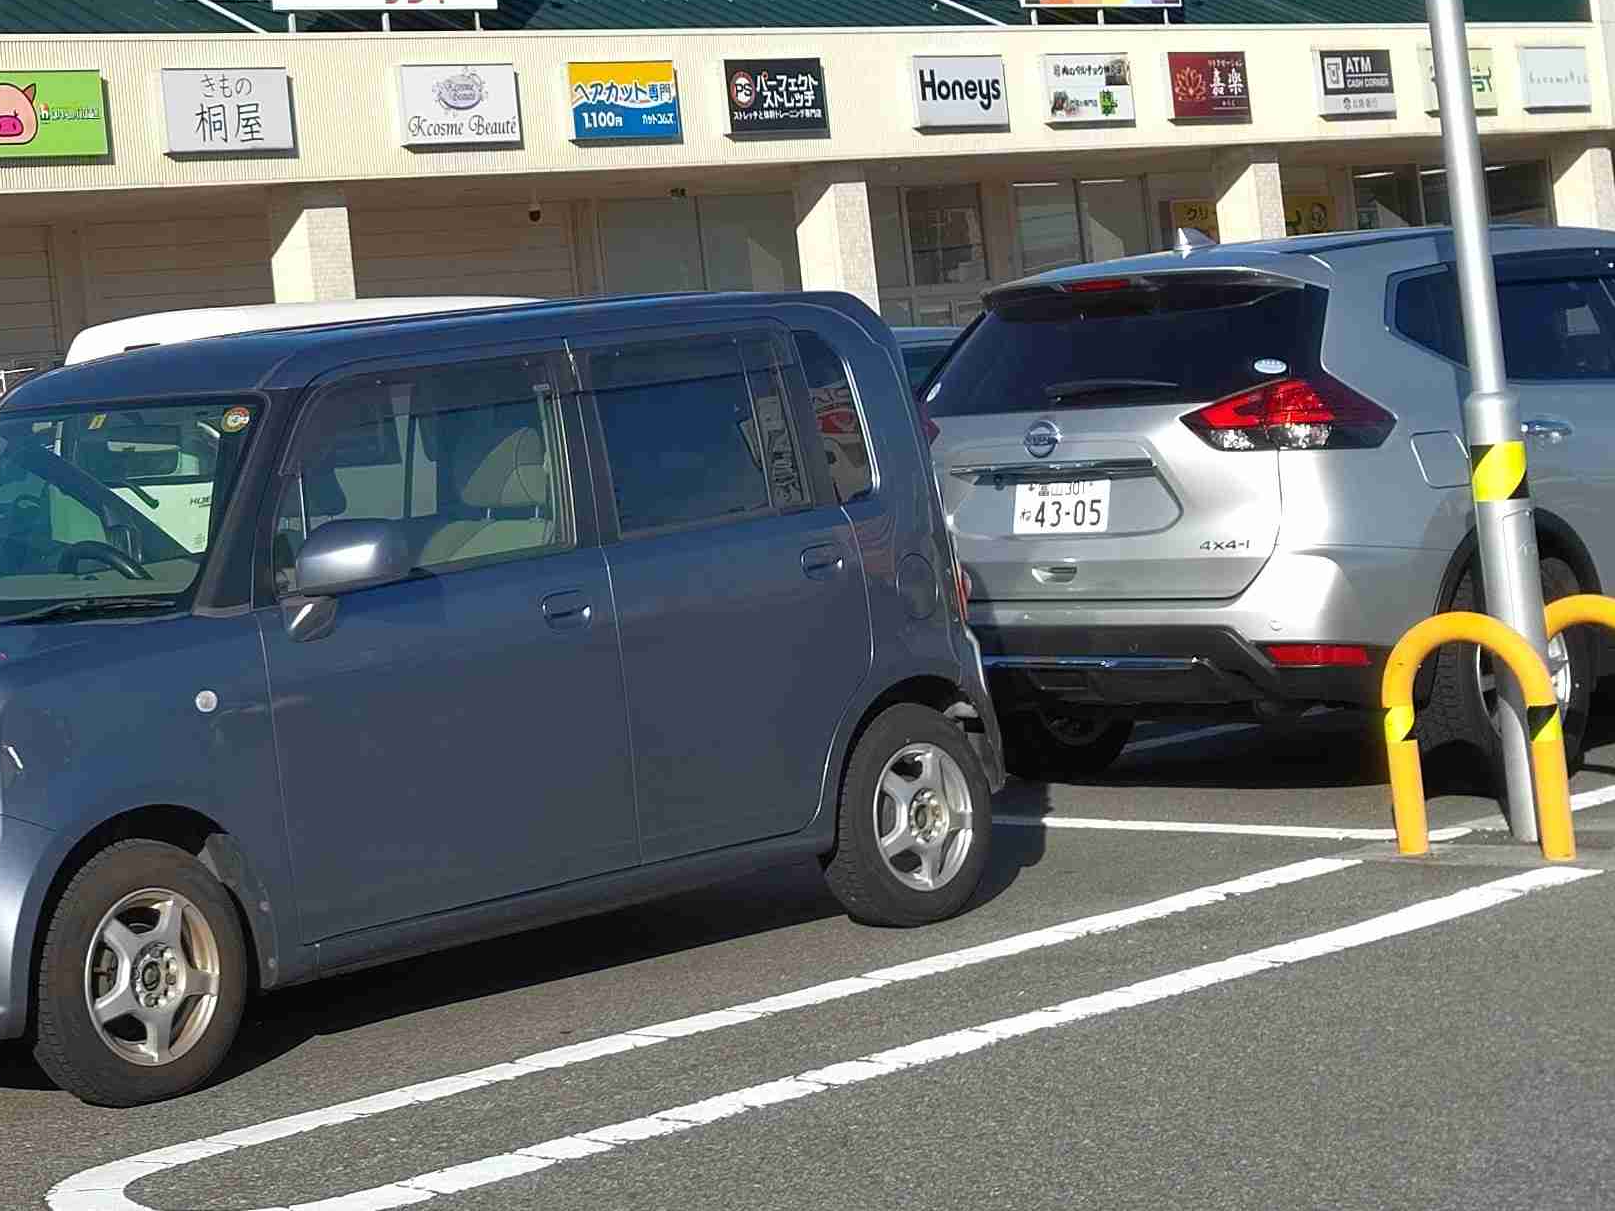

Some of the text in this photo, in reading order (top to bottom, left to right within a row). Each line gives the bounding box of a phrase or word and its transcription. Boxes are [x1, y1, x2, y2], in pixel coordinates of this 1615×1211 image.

[1345, 56, 1372, 73] ATM
[200, 74, 253, 99] きもの
[756, 71, 819, 92] パーフェクト
[919, 69, 1001, 110] Honeys
[762, 90, 816, 108] ストレッチ
[195, 102, 265, 143] 桐屋
[468, 115, 517, 135] Beauté
[1034, 500, 1102, 528] 43-05
